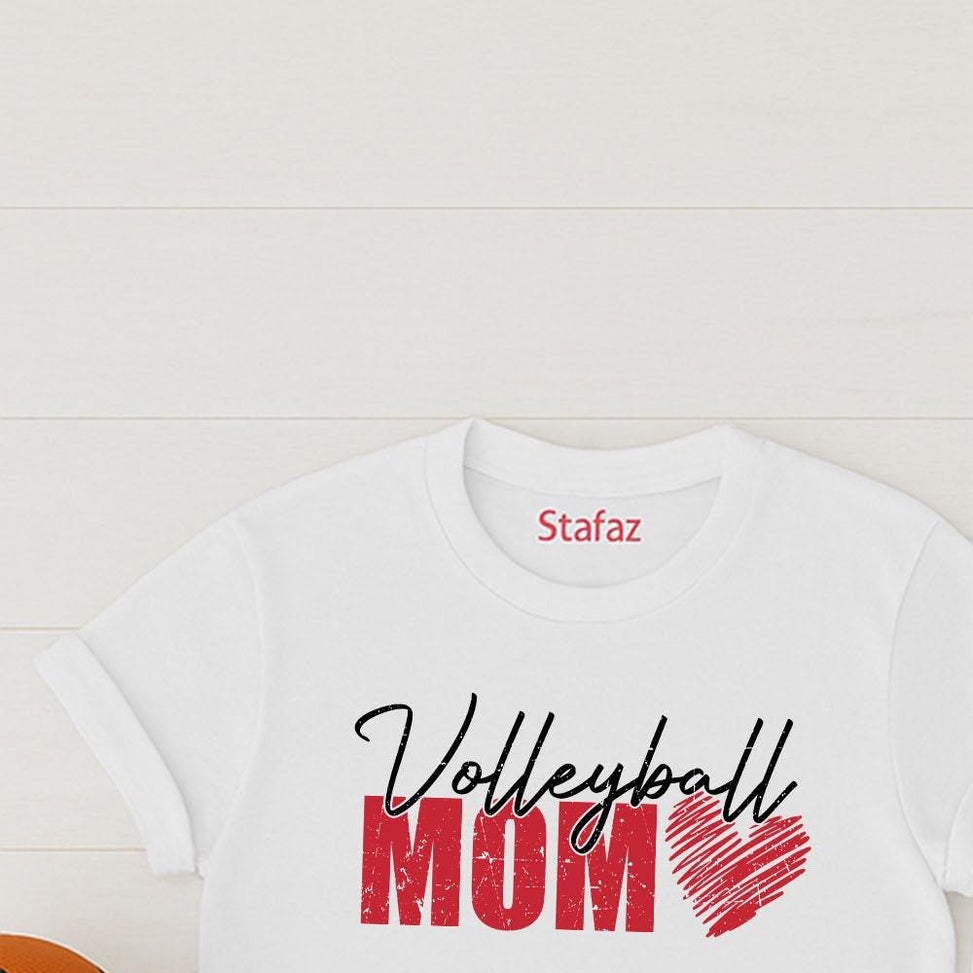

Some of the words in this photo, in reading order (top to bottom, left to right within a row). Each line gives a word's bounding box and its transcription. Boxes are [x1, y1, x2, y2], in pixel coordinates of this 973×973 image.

[538, 509, 641, 543] Stafaz
[355, 692, 797, 854] Volleyball
[360, 795, 658, 933] MOM
